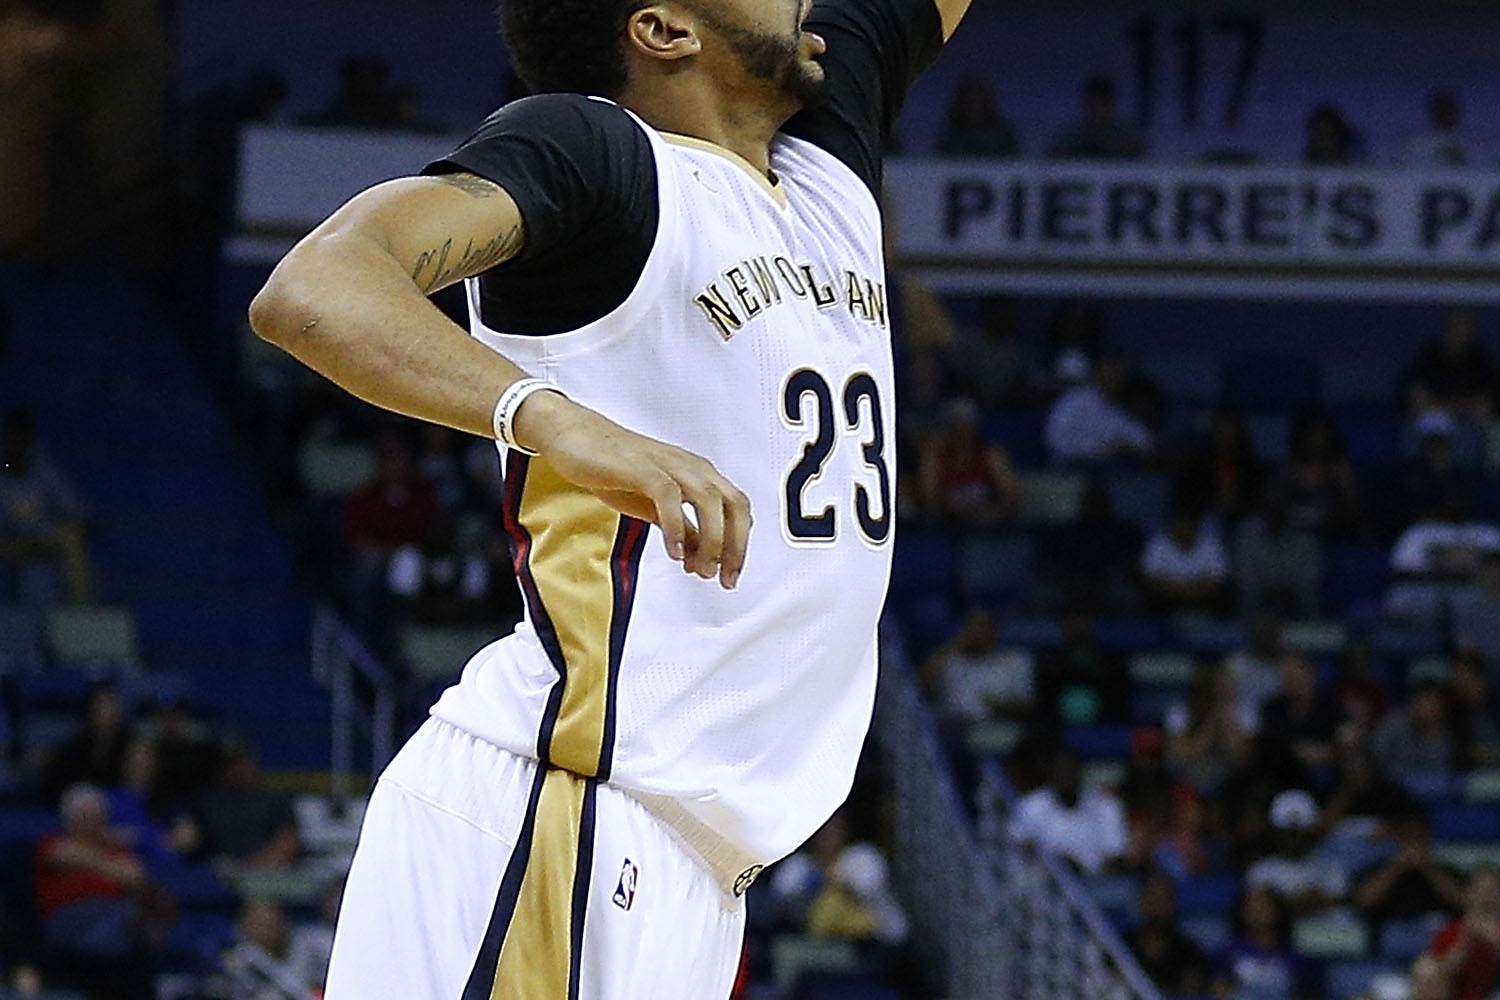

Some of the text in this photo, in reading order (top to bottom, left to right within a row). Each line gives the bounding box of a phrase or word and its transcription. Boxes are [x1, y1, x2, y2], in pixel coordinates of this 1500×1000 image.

[1124, 14, 1263, 132] 117
[939, 178, 1382, 250] PIERRE'S
[782, 365, 893, 543] 23
